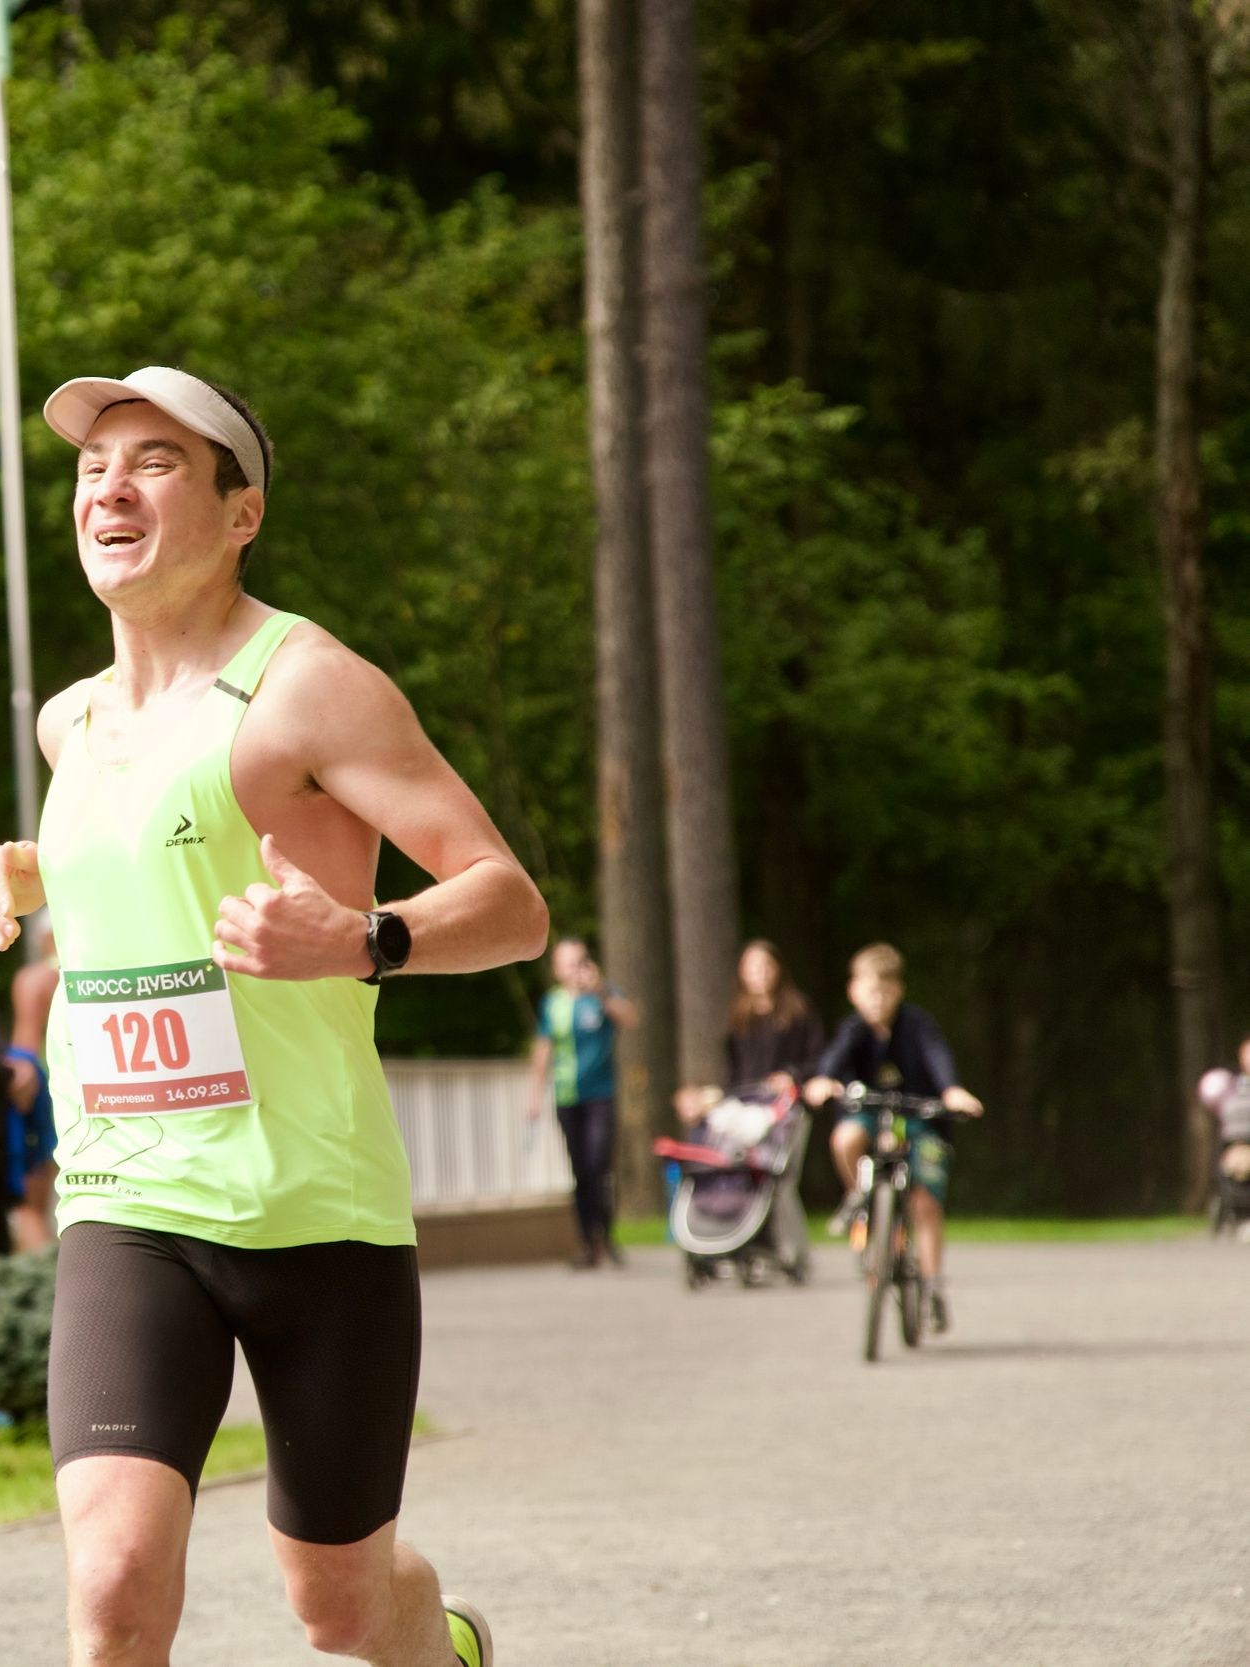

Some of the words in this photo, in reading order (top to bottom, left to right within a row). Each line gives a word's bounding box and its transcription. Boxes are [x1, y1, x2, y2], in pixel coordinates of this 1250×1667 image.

[165, 836, 206, 847] DEMIX
[76, 978, 132, 996] КРОСС
[136, 969, 206, 996] ДУБКИ
[102, 1008, 190, 1073] 120
[97, 1093, 155, 1106] Апрелевка
[165, 1082, 231, 1102] 14.09.25
[67, 1174, 115, 1185] DEMIX
[91, 1424, 137, 1432] EVADICT
